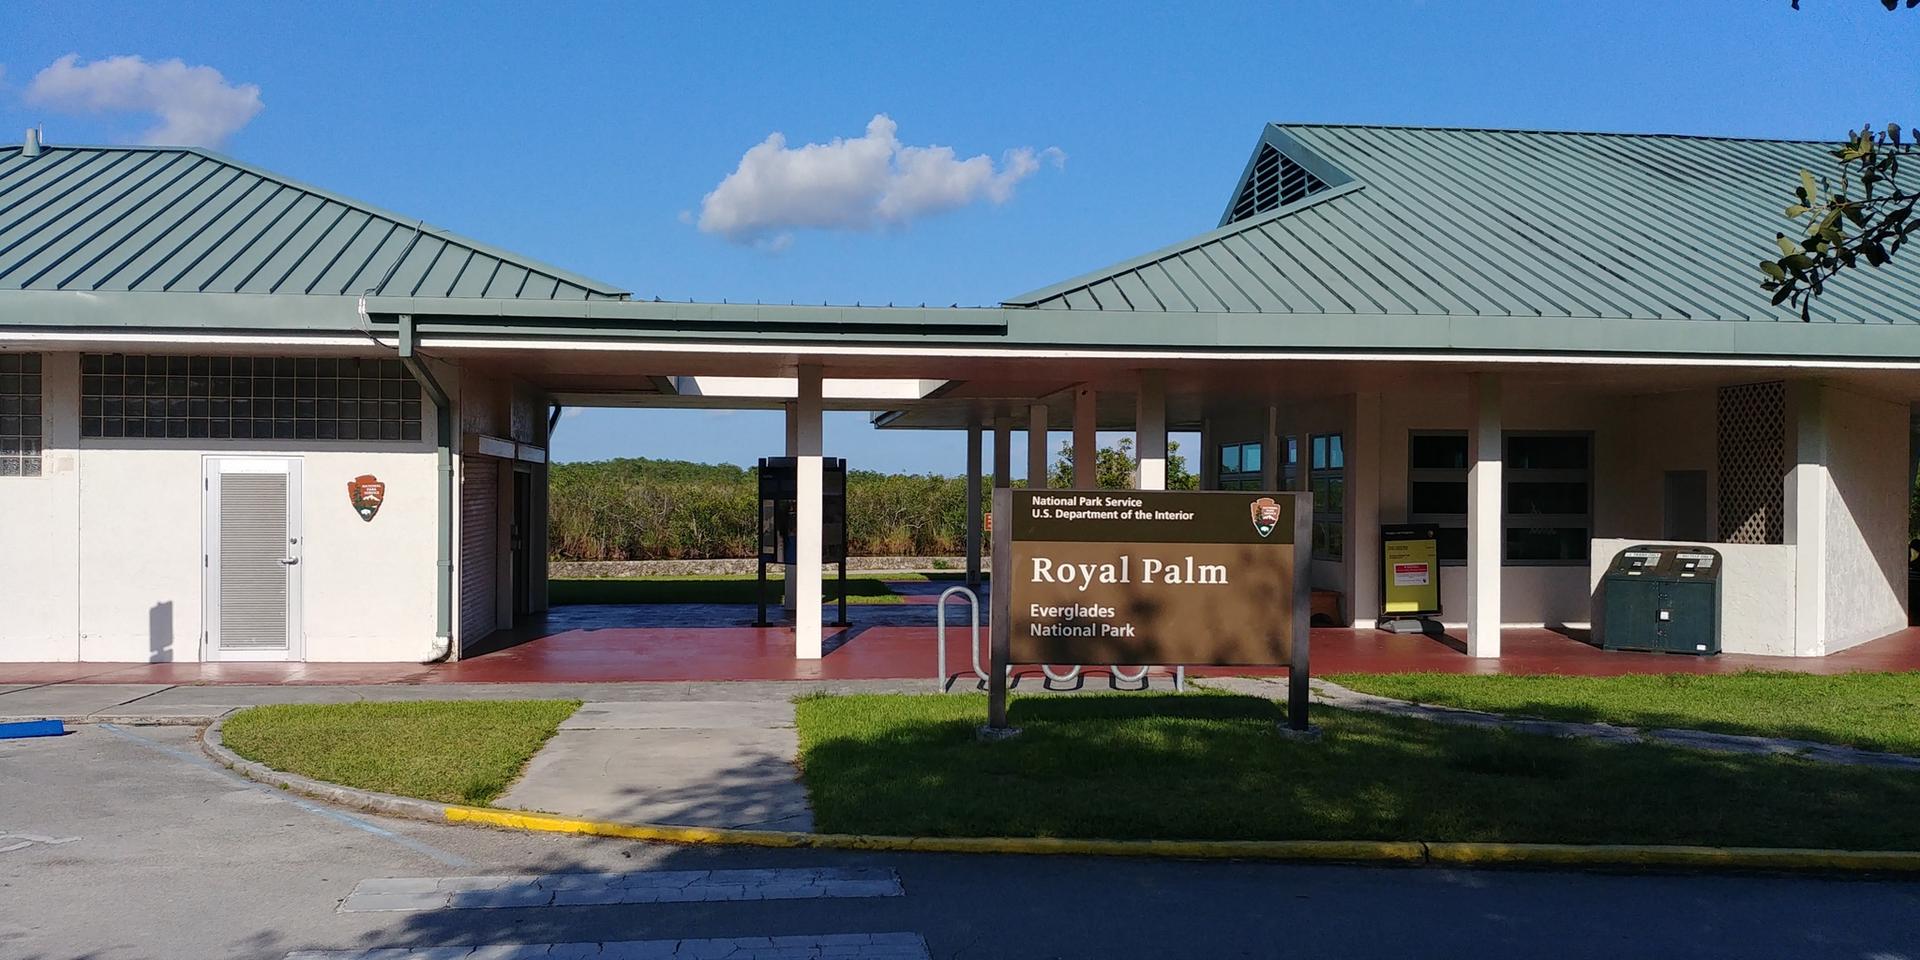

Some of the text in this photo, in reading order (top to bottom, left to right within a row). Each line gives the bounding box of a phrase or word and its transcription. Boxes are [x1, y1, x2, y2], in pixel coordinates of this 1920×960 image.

[1032, 496, 1142, 507] National Park Service
[1032, 509, 1194, 521] U.S. Department of the Interior
[1031, 555, 1229, 592] Royal Palm
[1030, 603, 1115, 620] Everglades
[1030, 623, 1135, 637] National Park
